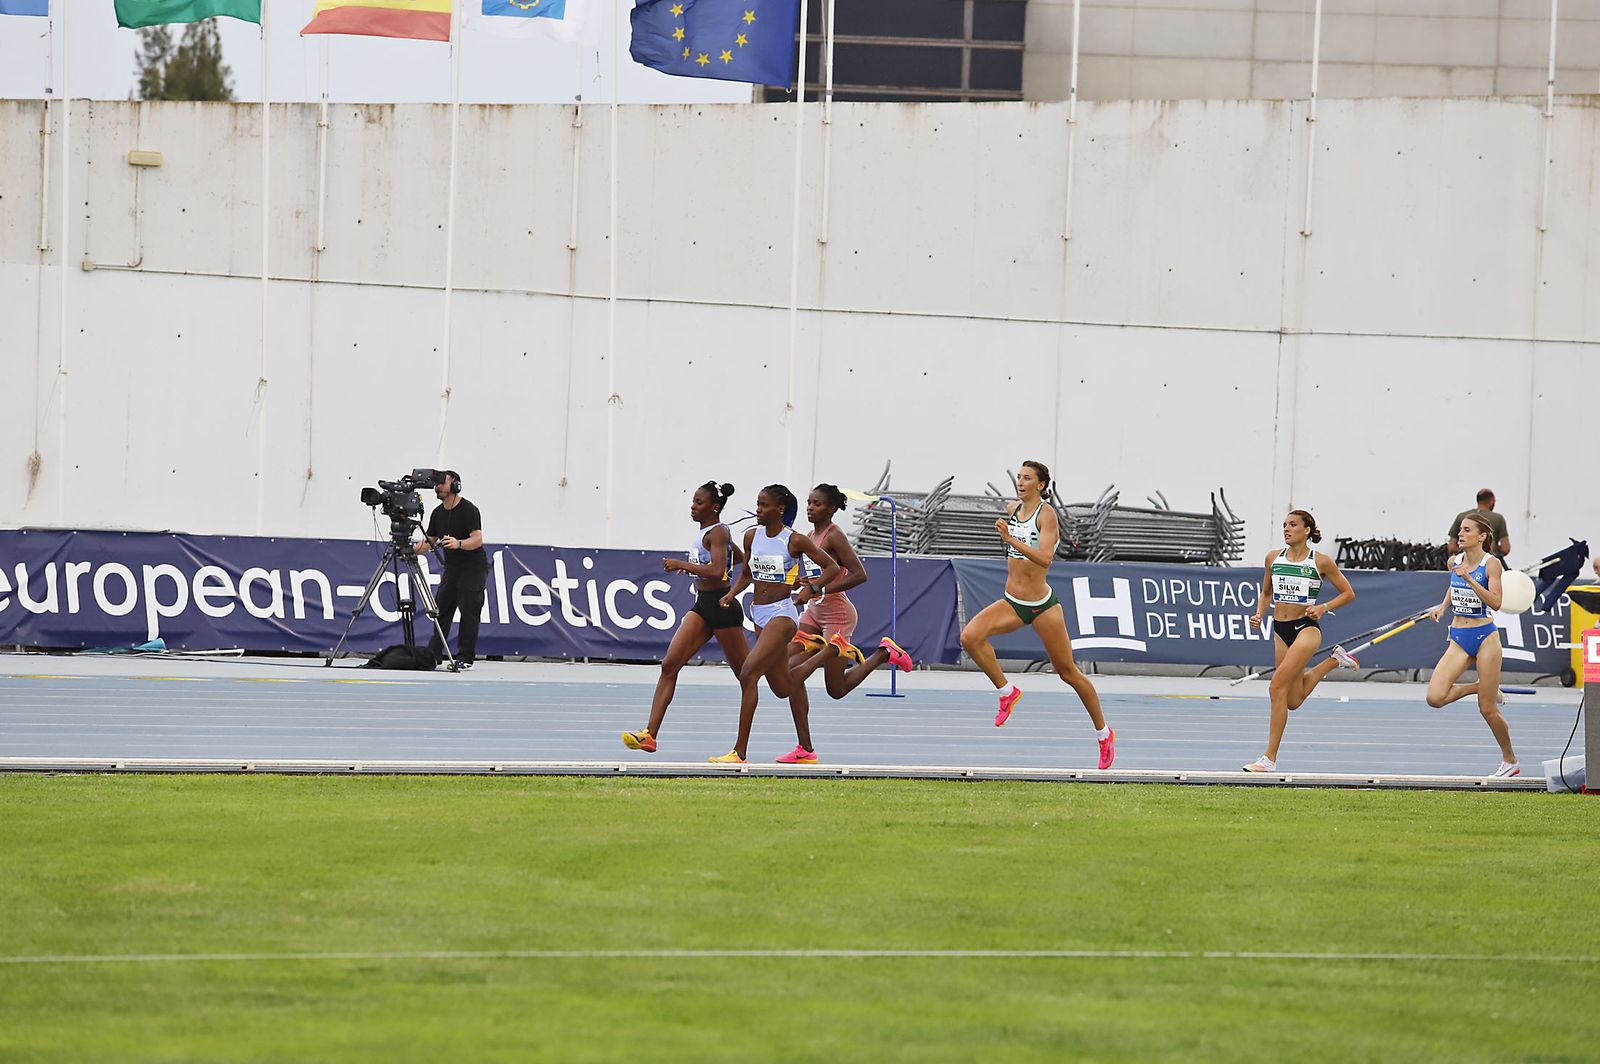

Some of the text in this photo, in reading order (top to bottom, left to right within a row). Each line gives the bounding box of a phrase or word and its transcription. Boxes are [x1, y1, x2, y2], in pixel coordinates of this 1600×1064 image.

[0, 551, 677, 641] uropean-atletics
[1142, 578, 1275, 608] DIPUTACI
[1146, 612, 1274, 641] DE HUELV
[1533, 623, 1565, 649] DE
